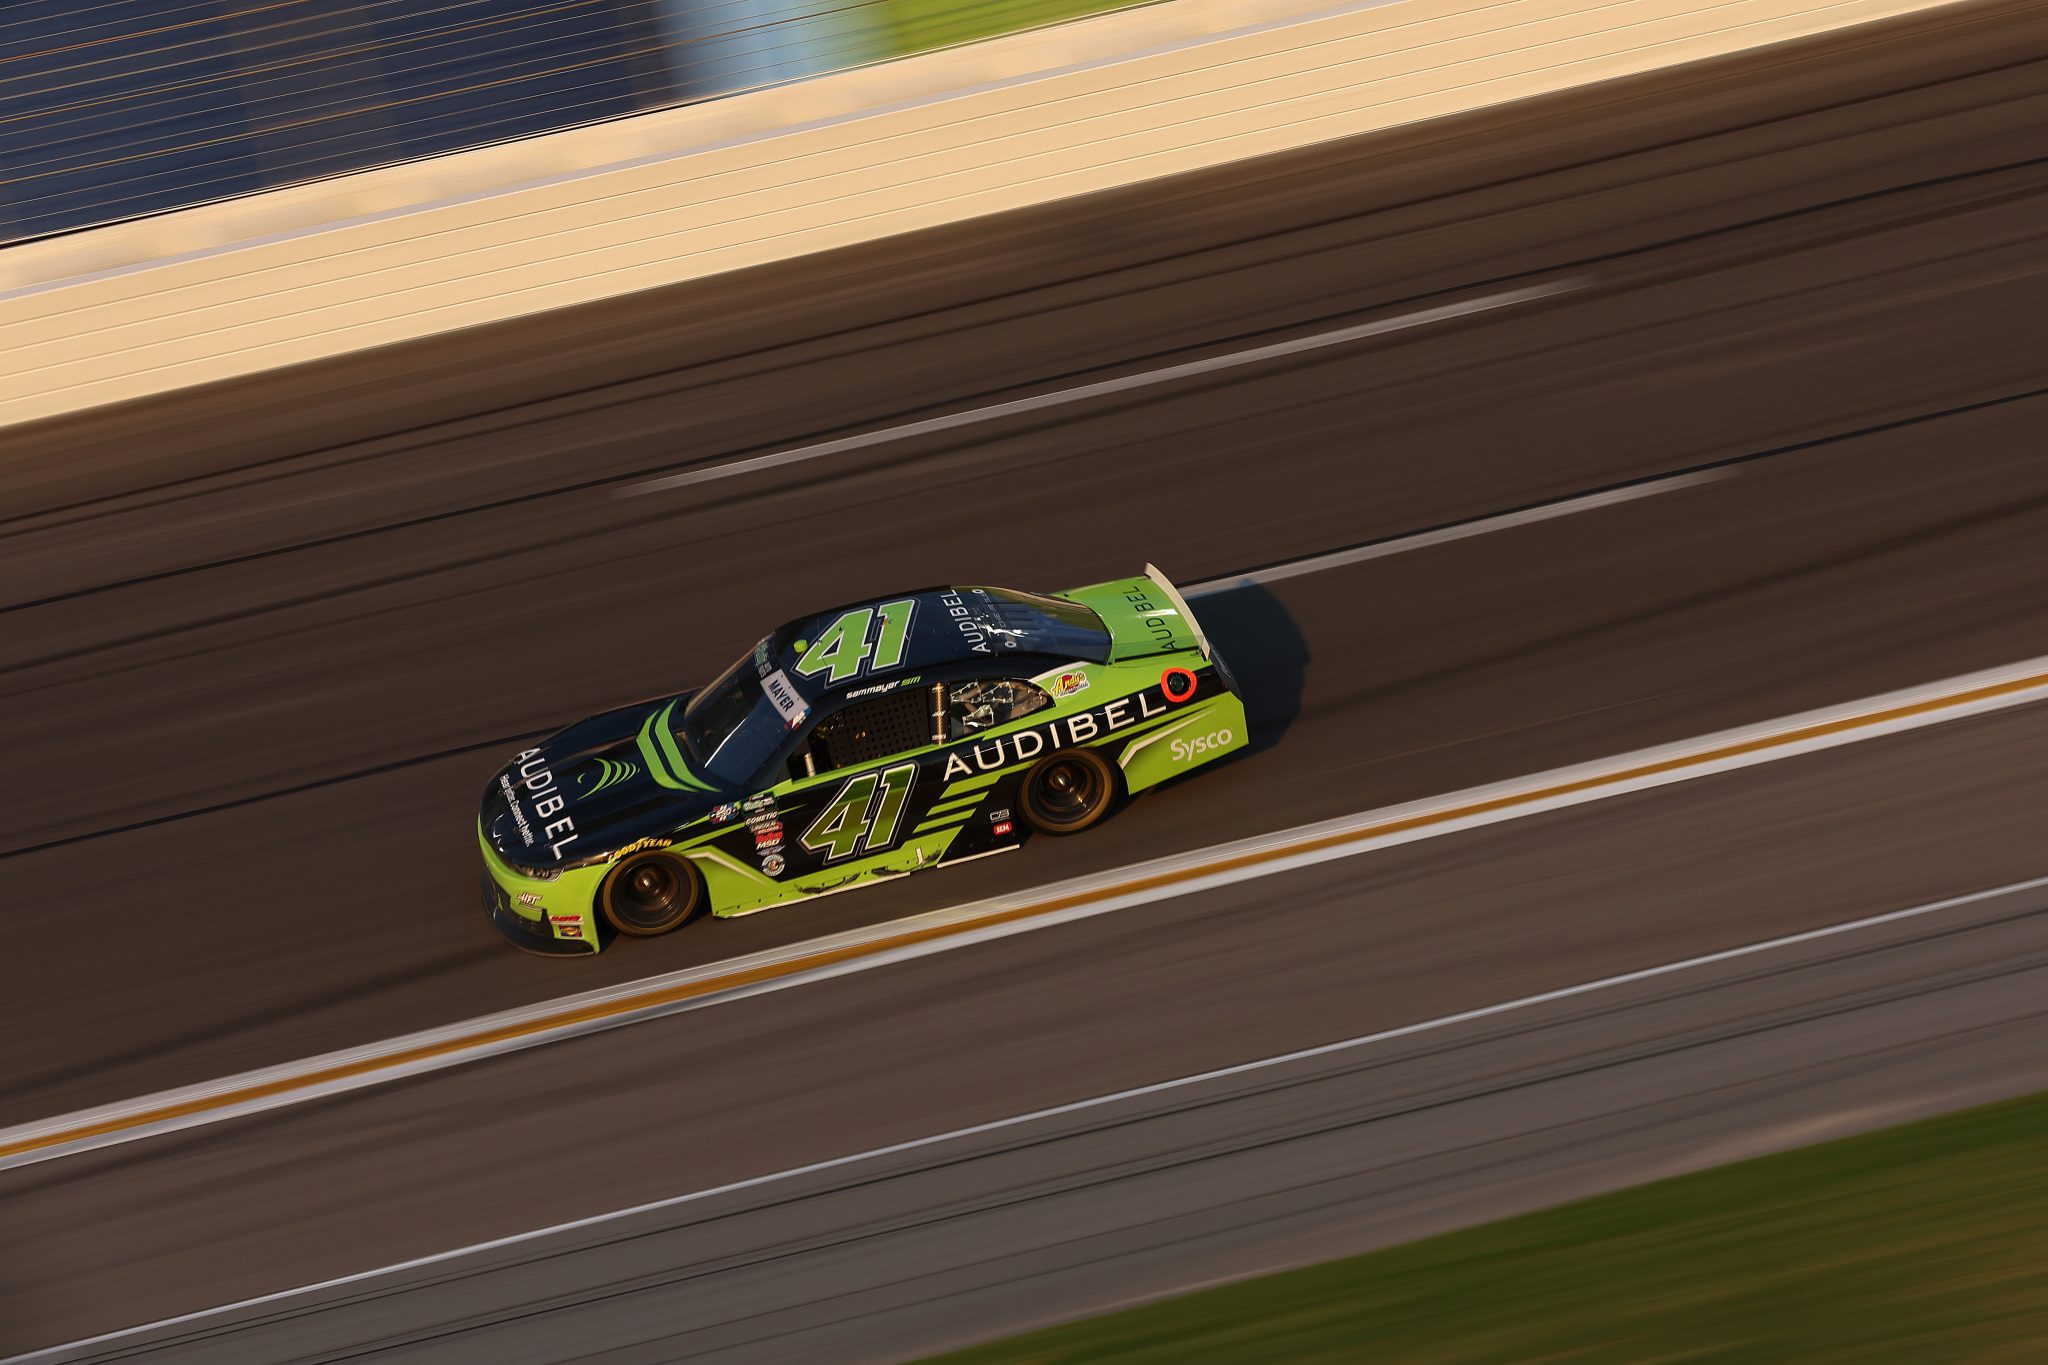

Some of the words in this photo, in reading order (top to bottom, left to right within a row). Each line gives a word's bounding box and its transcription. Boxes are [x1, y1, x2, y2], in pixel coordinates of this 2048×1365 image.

[794, 598, 916, 684] 41
[940, 588, 992, 653] AUDIBEL
[1122, 585, 1177, 651] AUDBEL
[767, 679, 795, 713] MAYER
[943, 692, 1167, 782] AUDIBEL
[1170, 728, 1233, 762] Sysco
[514, 747, 578, 860] AUDIBEL
[800, 762, 916, 861] 41
[606, 836, 673, 865] GOODYEAR
